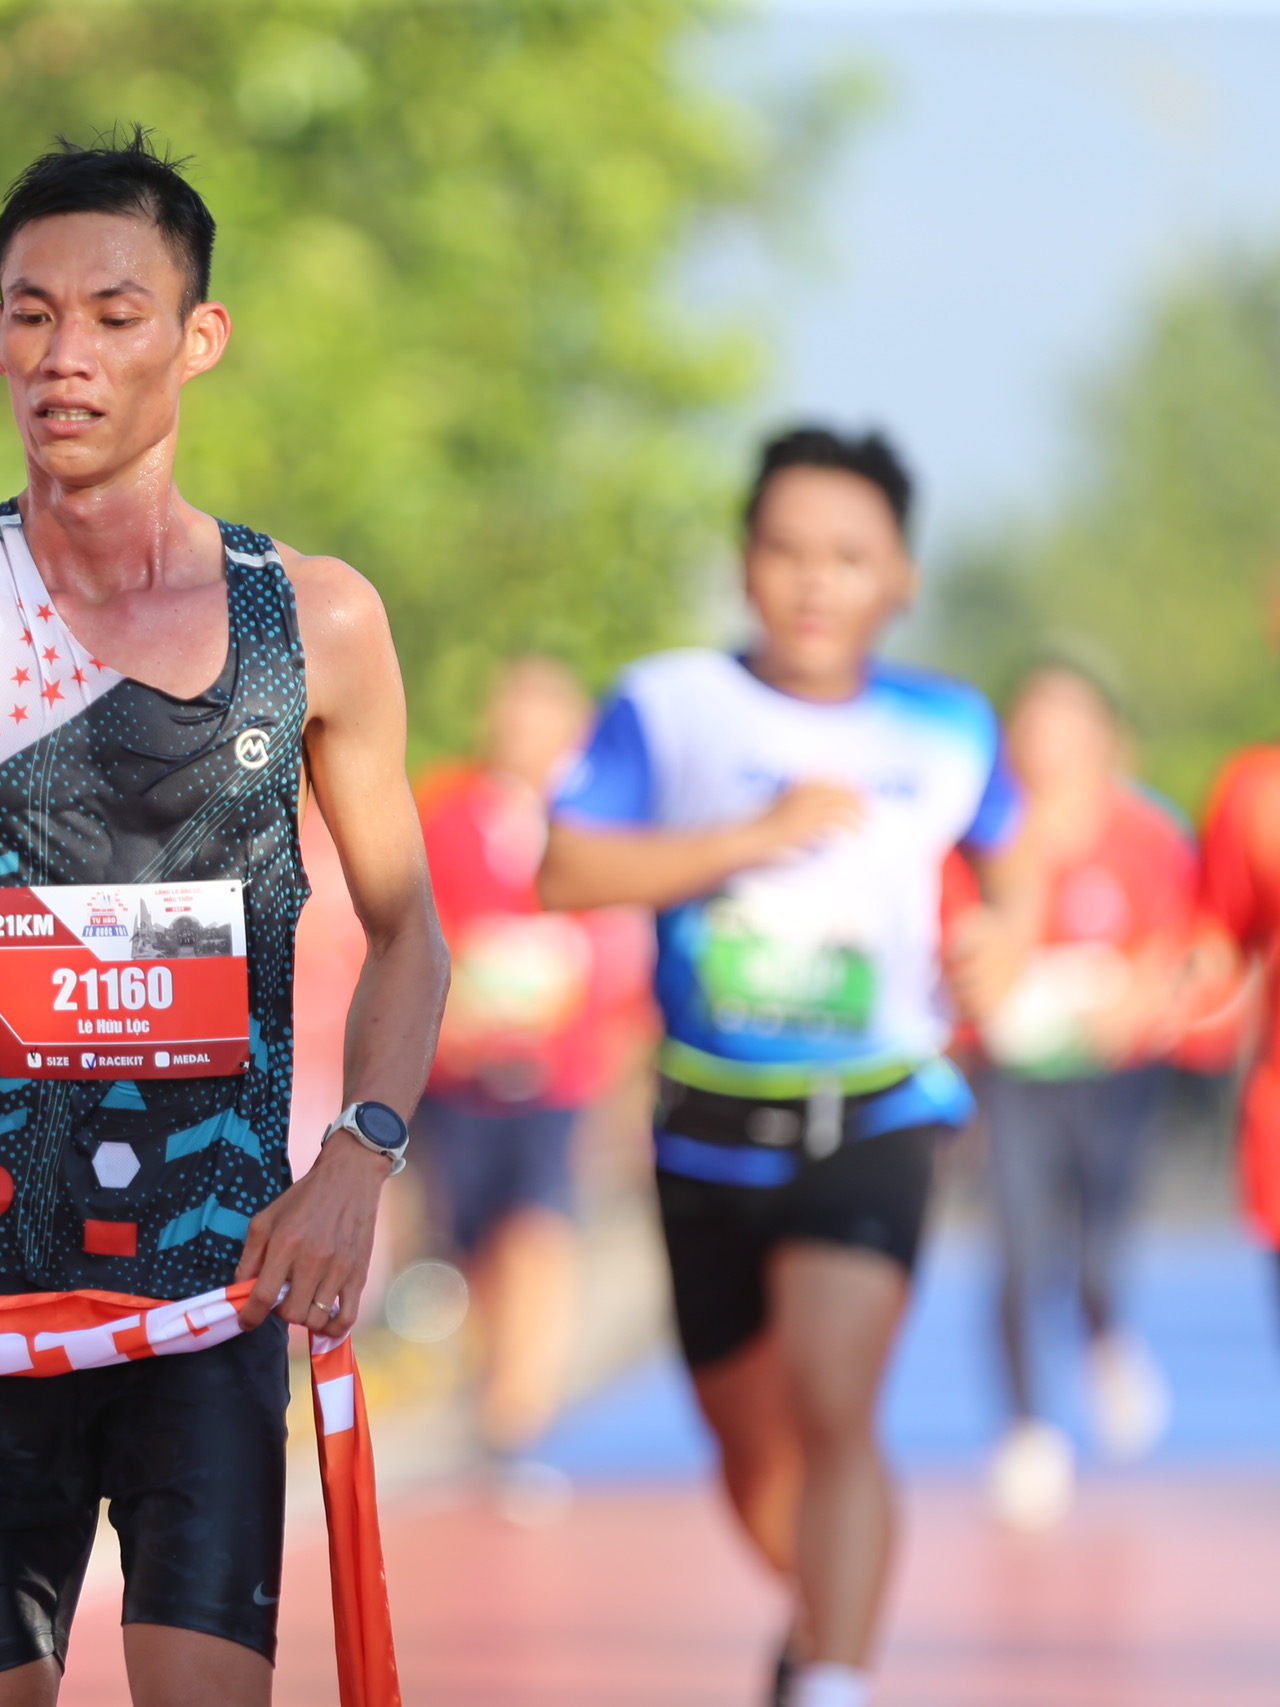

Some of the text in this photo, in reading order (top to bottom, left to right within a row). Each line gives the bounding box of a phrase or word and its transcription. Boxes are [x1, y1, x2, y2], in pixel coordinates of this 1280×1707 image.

[53, 966, 173, 1010] 21160
[78, 1019, 93, 1034] Lê
[126, 1018, 150, 1036] Lộc
[46, 1054, 210, 1066] SIZE RACEKIT MEDAL
